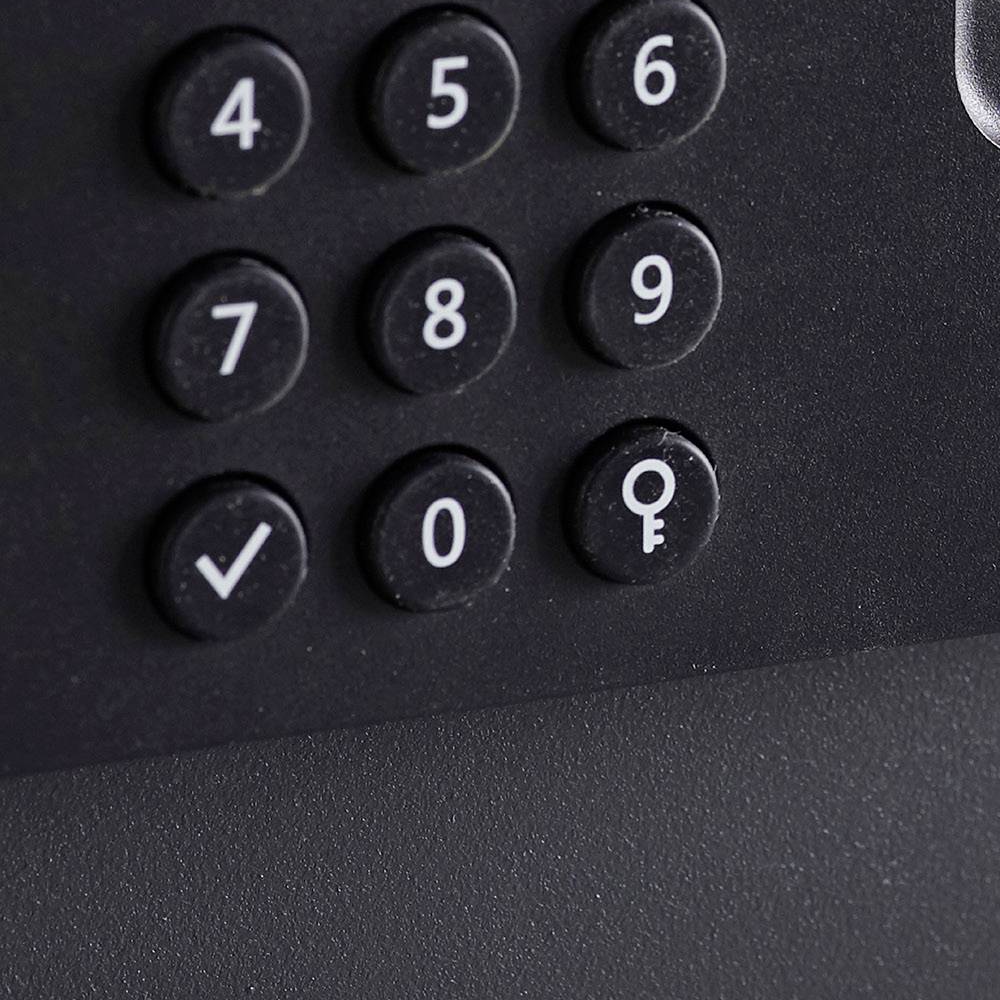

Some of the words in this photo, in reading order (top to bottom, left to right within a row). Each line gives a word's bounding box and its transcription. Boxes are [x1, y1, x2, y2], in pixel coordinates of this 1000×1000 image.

[426, 55, 469, 130] 5
[633, 34, 677, 106] 6
[210, 77, 262, 150] 4
[422, 277, 467, 350] 8
[630, 254, 674, 325] 9
[211, 301, 258, 376] 7
[421, 497, 466, 568] 0
